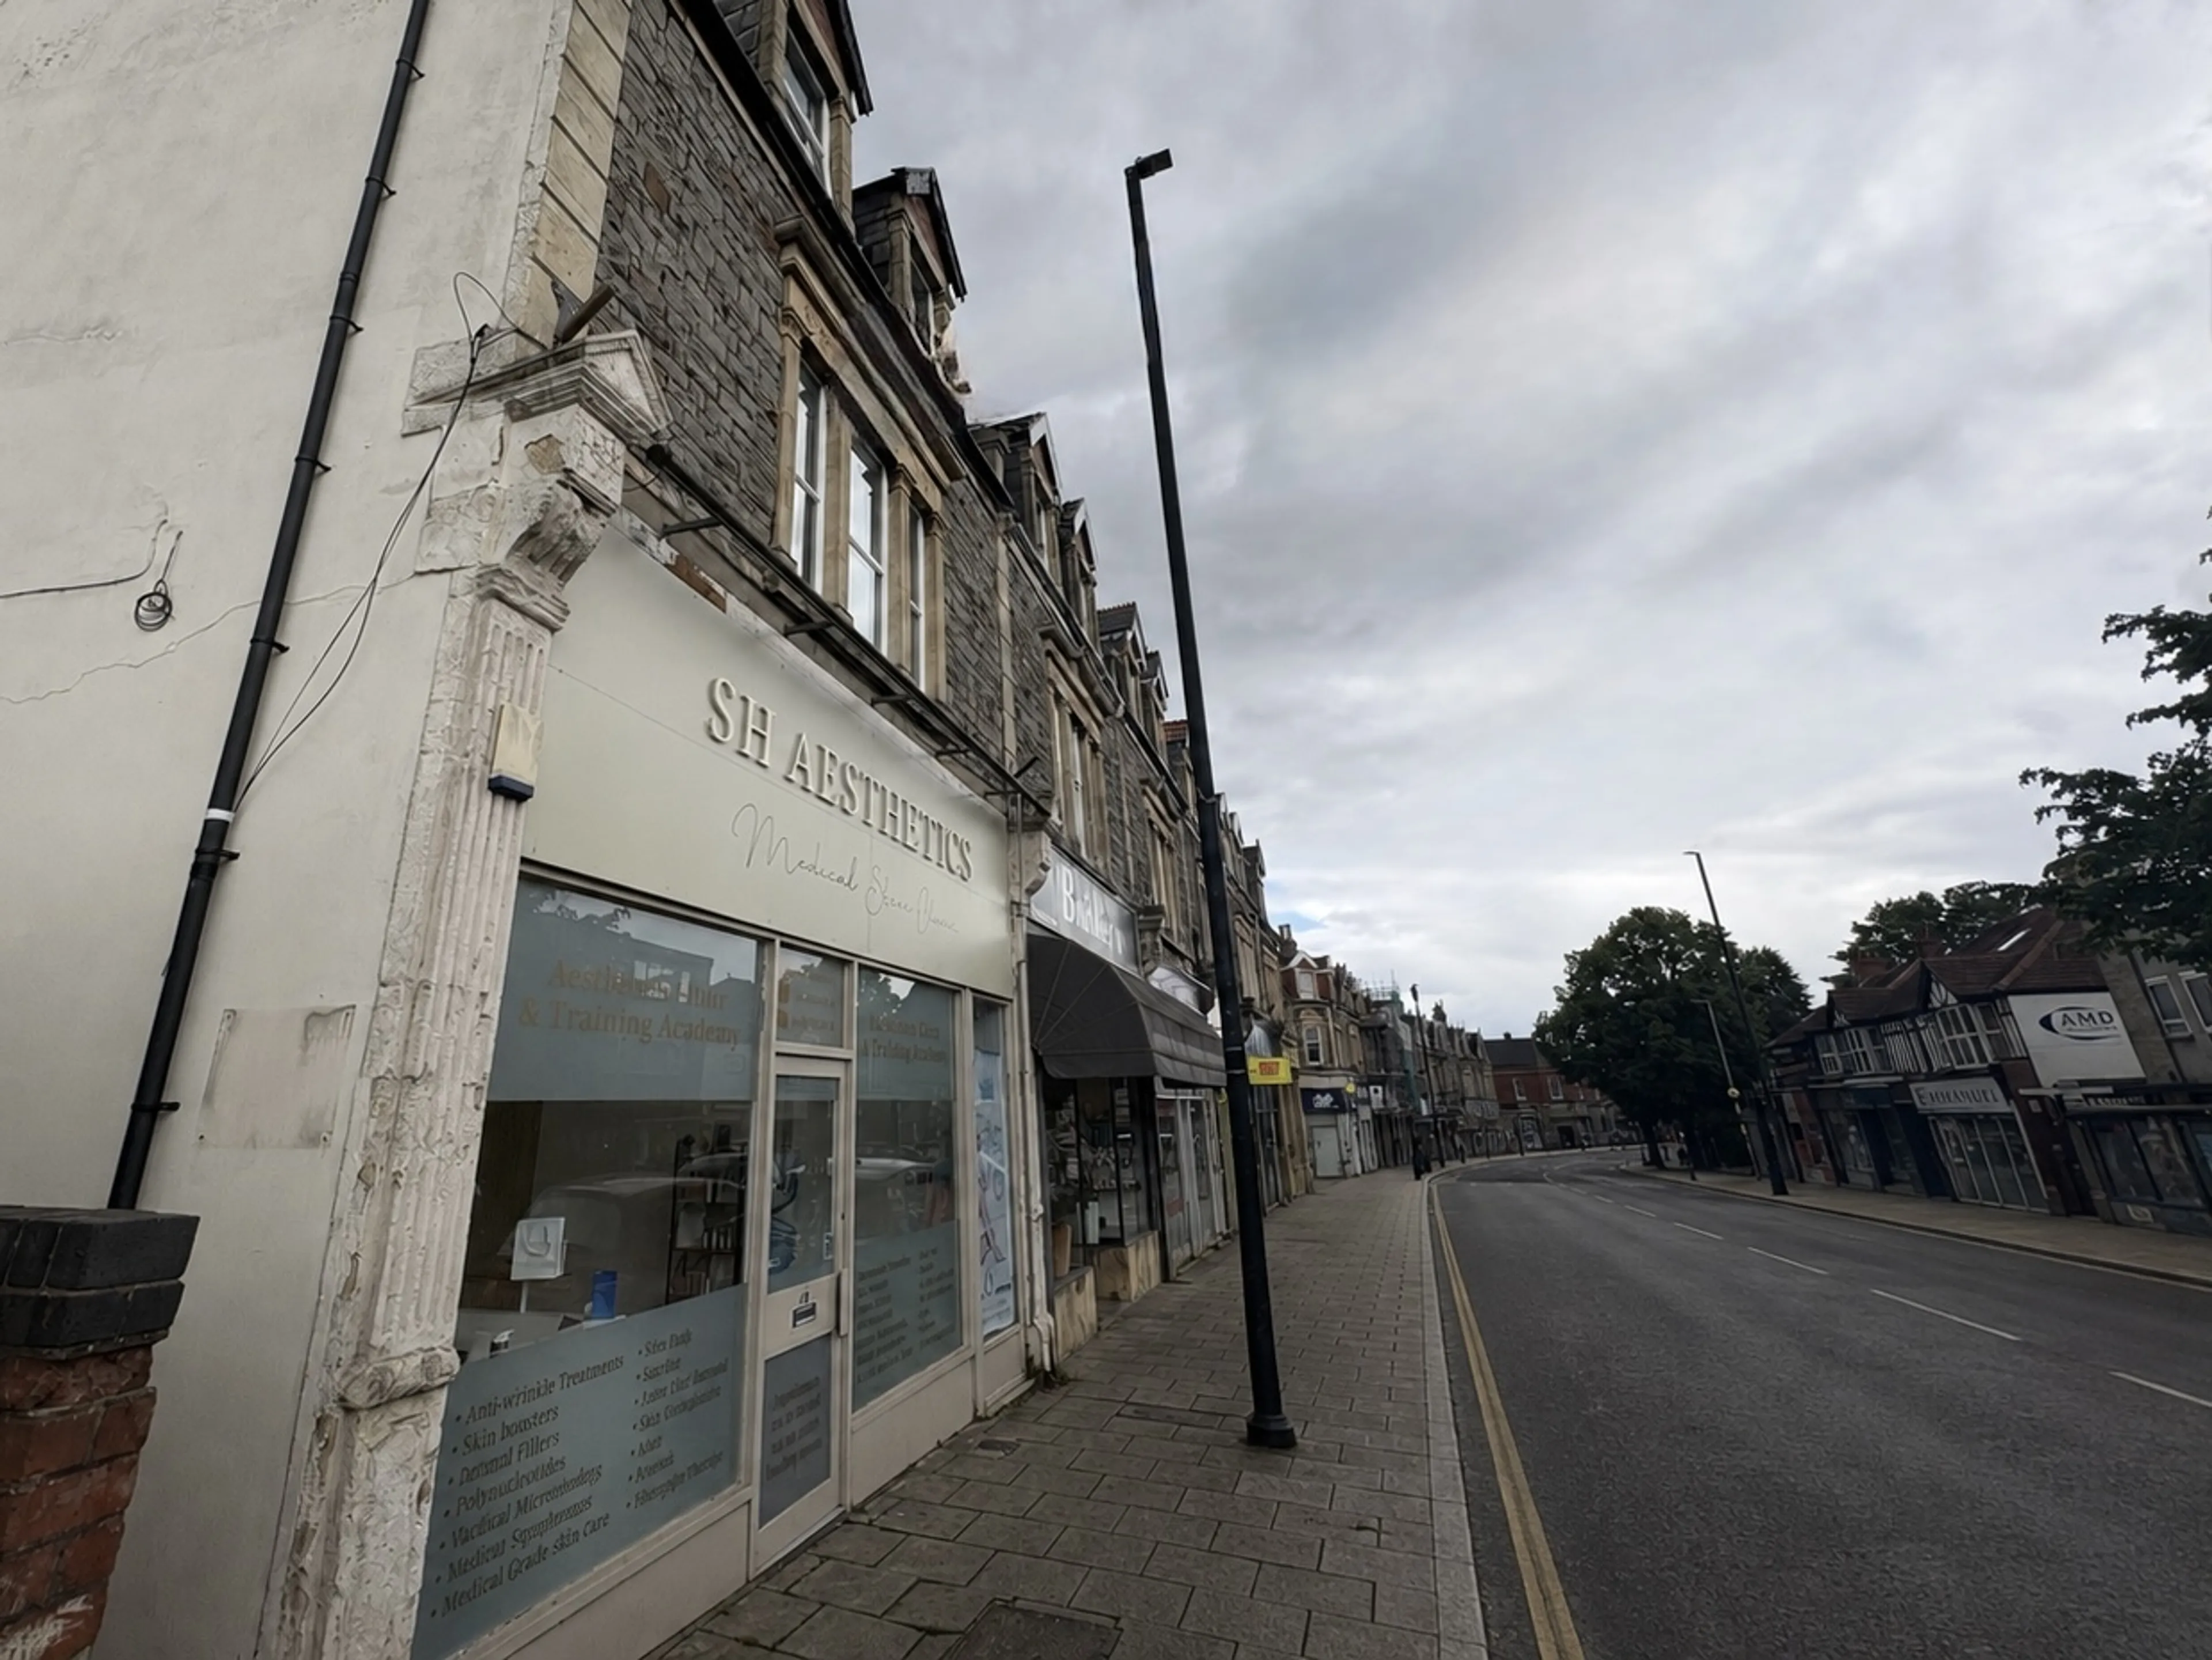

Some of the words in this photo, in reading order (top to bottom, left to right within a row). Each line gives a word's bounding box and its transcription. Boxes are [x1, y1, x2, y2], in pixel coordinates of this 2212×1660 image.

[704, 677, 777, 769] SH
[783, 732, 972, 882] AESTHETICS
[730, 803, 859, 891] Medical
[548, 1000, 653, 1044] Training
[657, 1014, 741, 1052] Academy
[2061, 1009, 2115, 1027] AMD
[558, 1356, 624, 1393] Treatments
[461, 1428, 496, 1457] Skin
[441, 1564, 504, 1619] Medical
[507, 1544, 550, 1583] Grade
